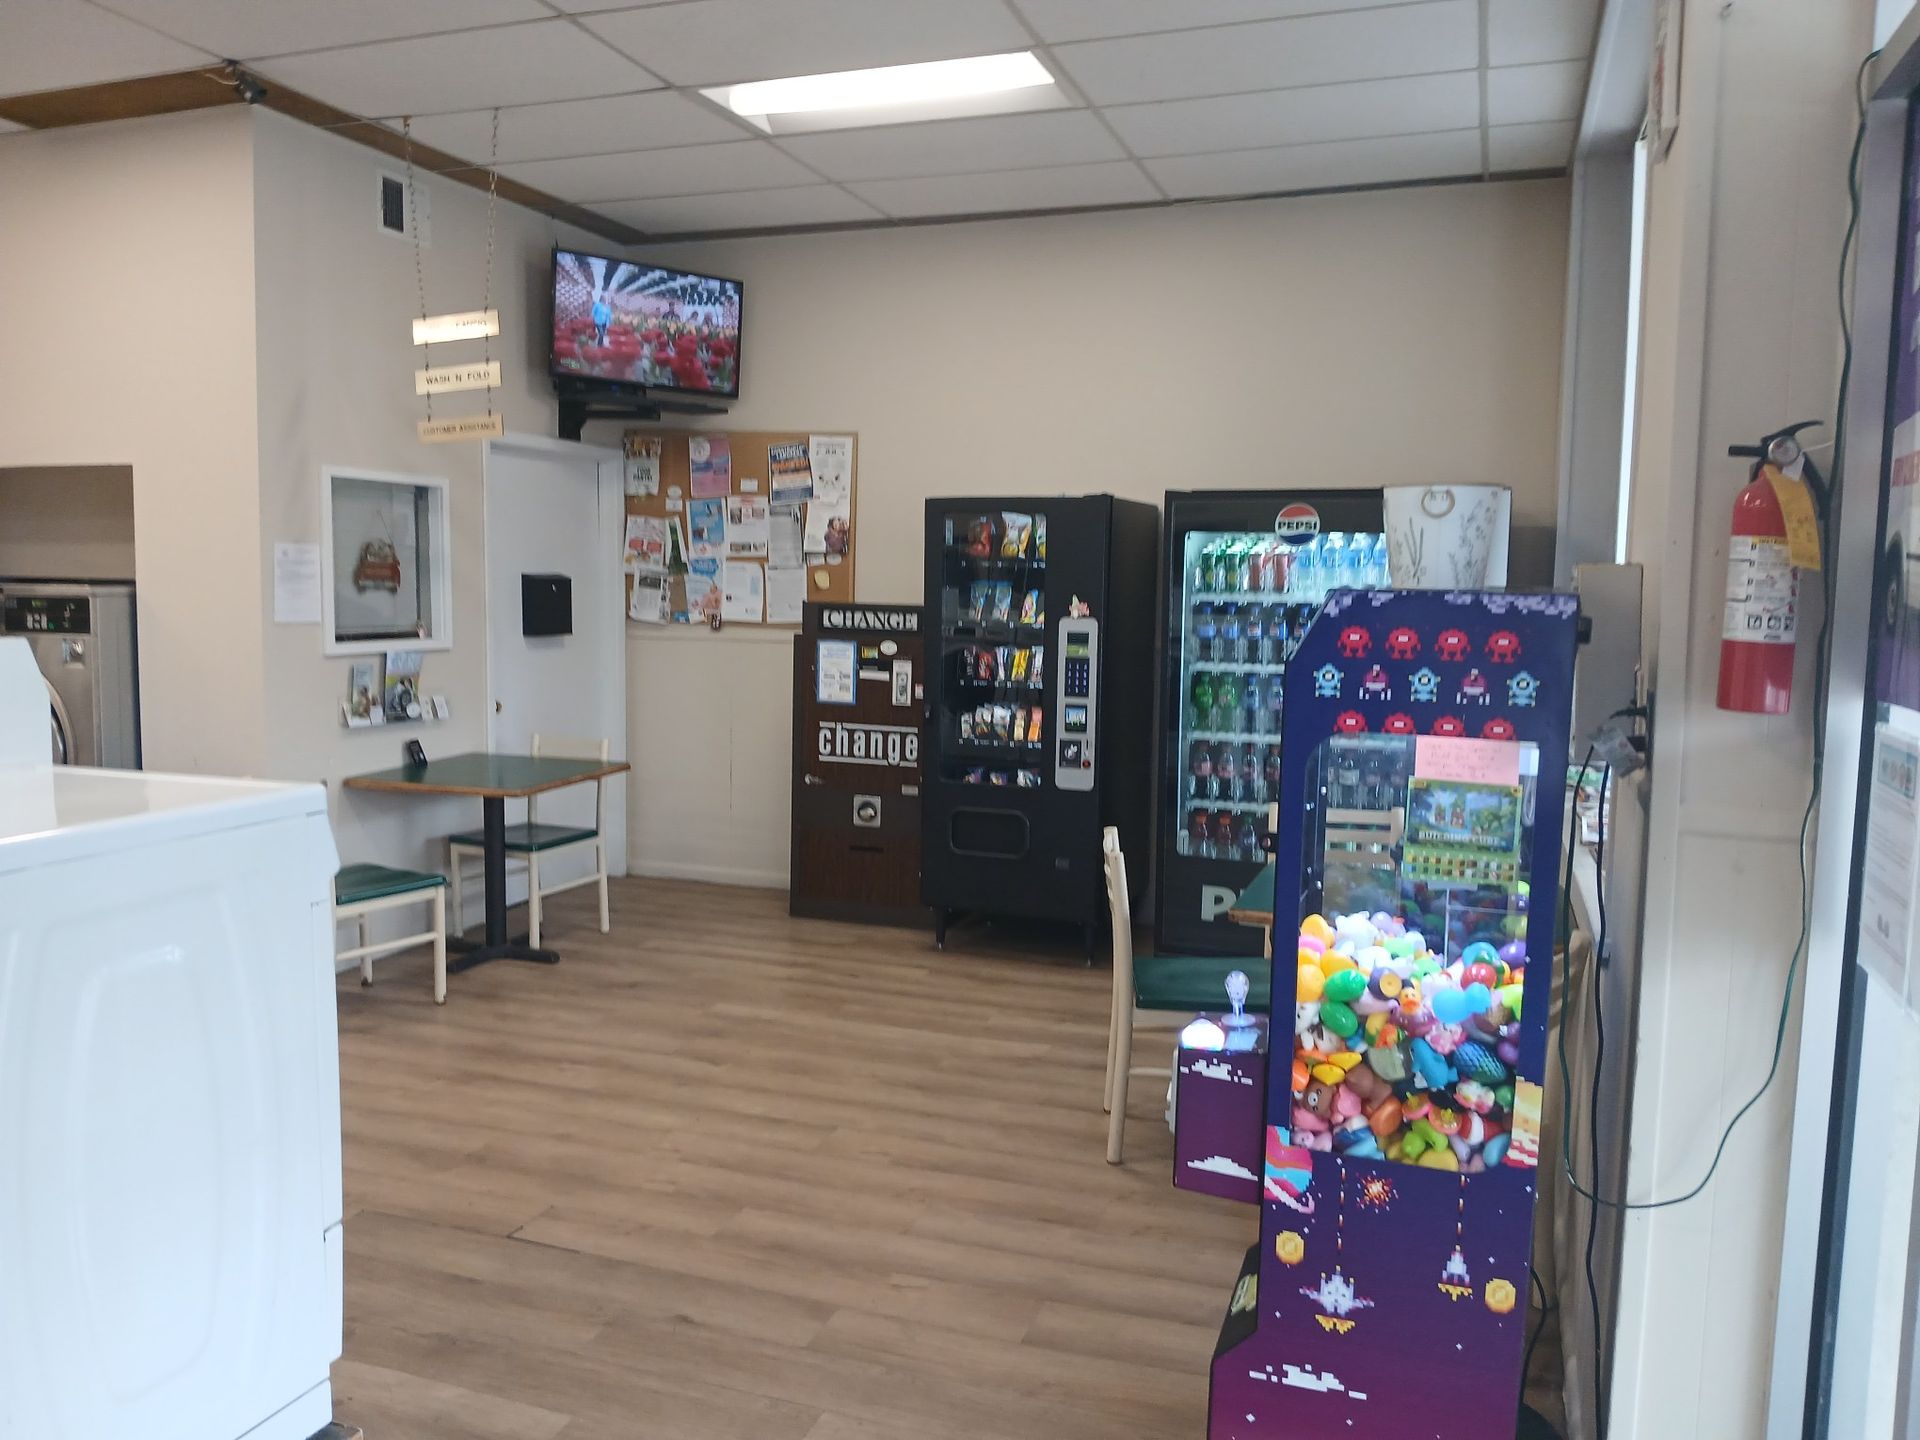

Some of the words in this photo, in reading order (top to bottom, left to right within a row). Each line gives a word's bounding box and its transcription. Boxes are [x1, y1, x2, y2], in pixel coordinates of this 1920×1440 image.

[425, 374, 450, 385] WASH
[455, 373, 462, 382] N
[467, 370, 490, 381] FOLD
[1277, 521, 1317, 531] PEPSI
[827, 609, 918, 631] CHANGE
[818, 721, 918, 766] change
[1201, 884, 1243, 922] P
